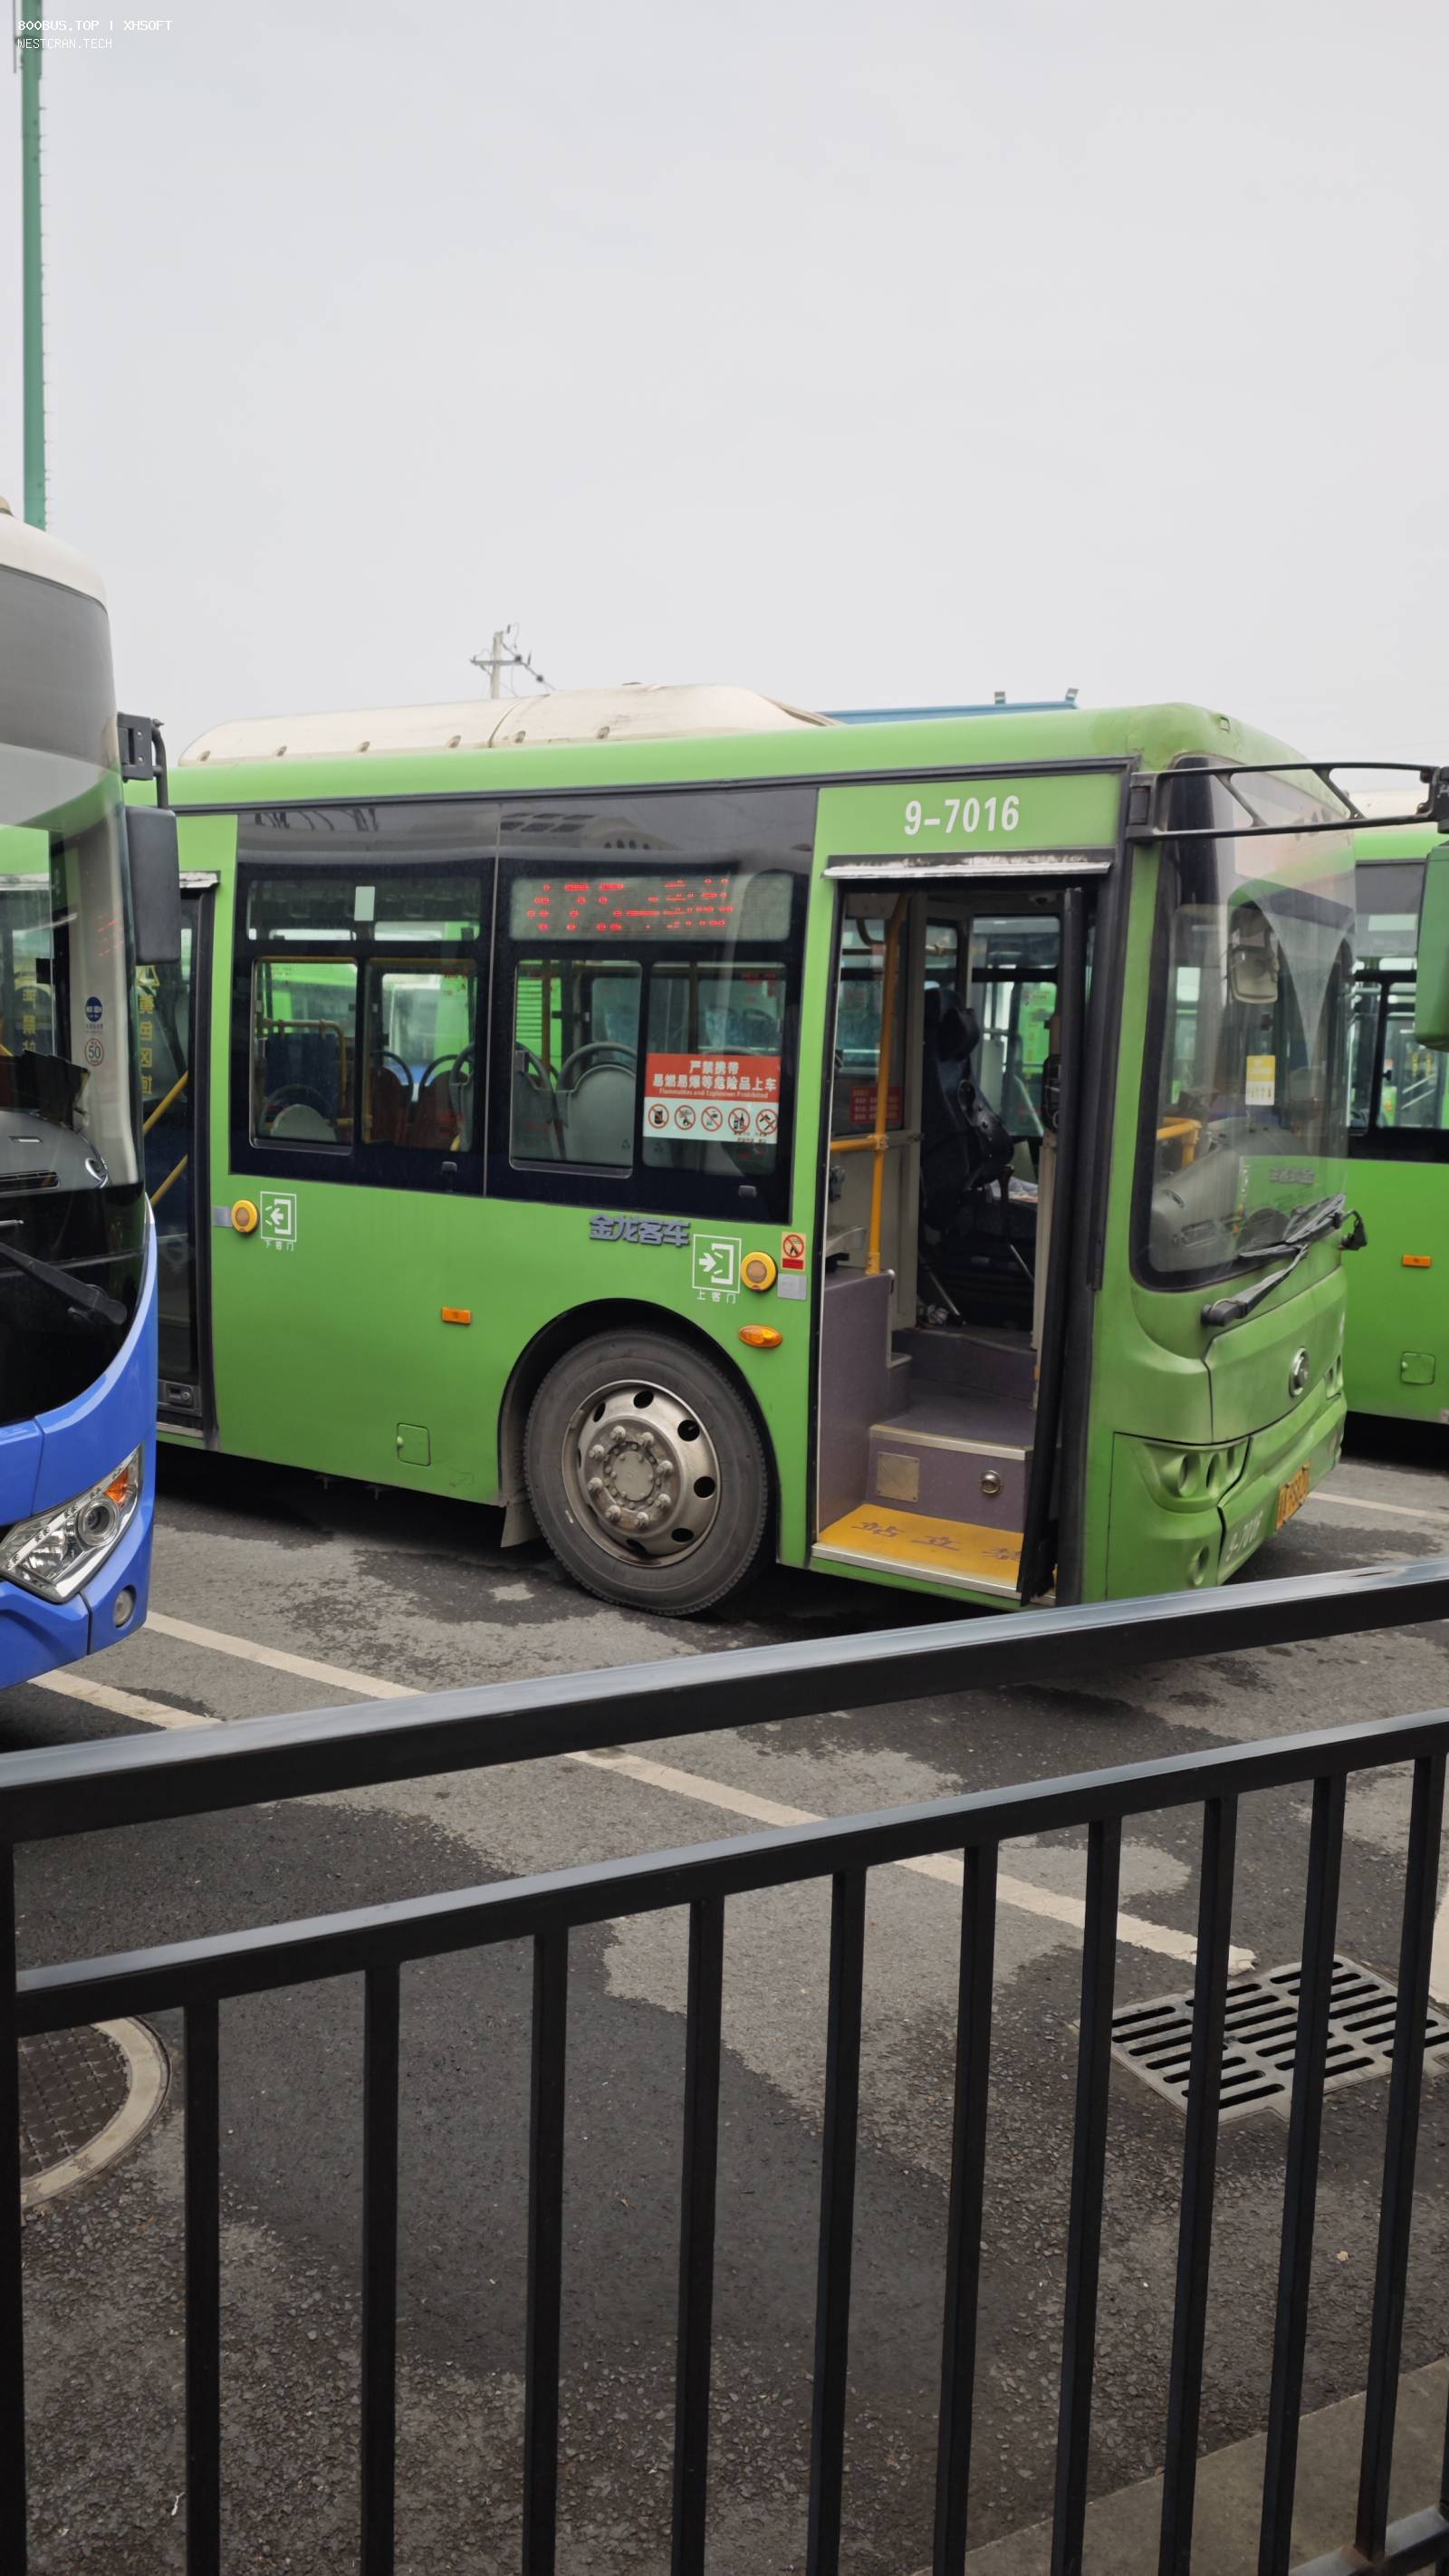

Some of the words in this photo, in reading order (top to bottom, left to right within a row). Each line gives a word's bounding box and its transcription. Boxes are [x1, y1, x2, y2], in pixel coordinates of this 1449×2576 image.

[904, 795, 1020, 836] 9-7016
[88, 1045, 101, 1059] 50
[689, 1060, 740, 1074] 严禁携带
[652, 1073, 778, 1092] 易燃易爆等危险品上车
[590, 1214, 691, 1247] 金龙客车
[264, 1239, 295, 1252] 下客门
[696, 1289, 737, 1304] 上客门
